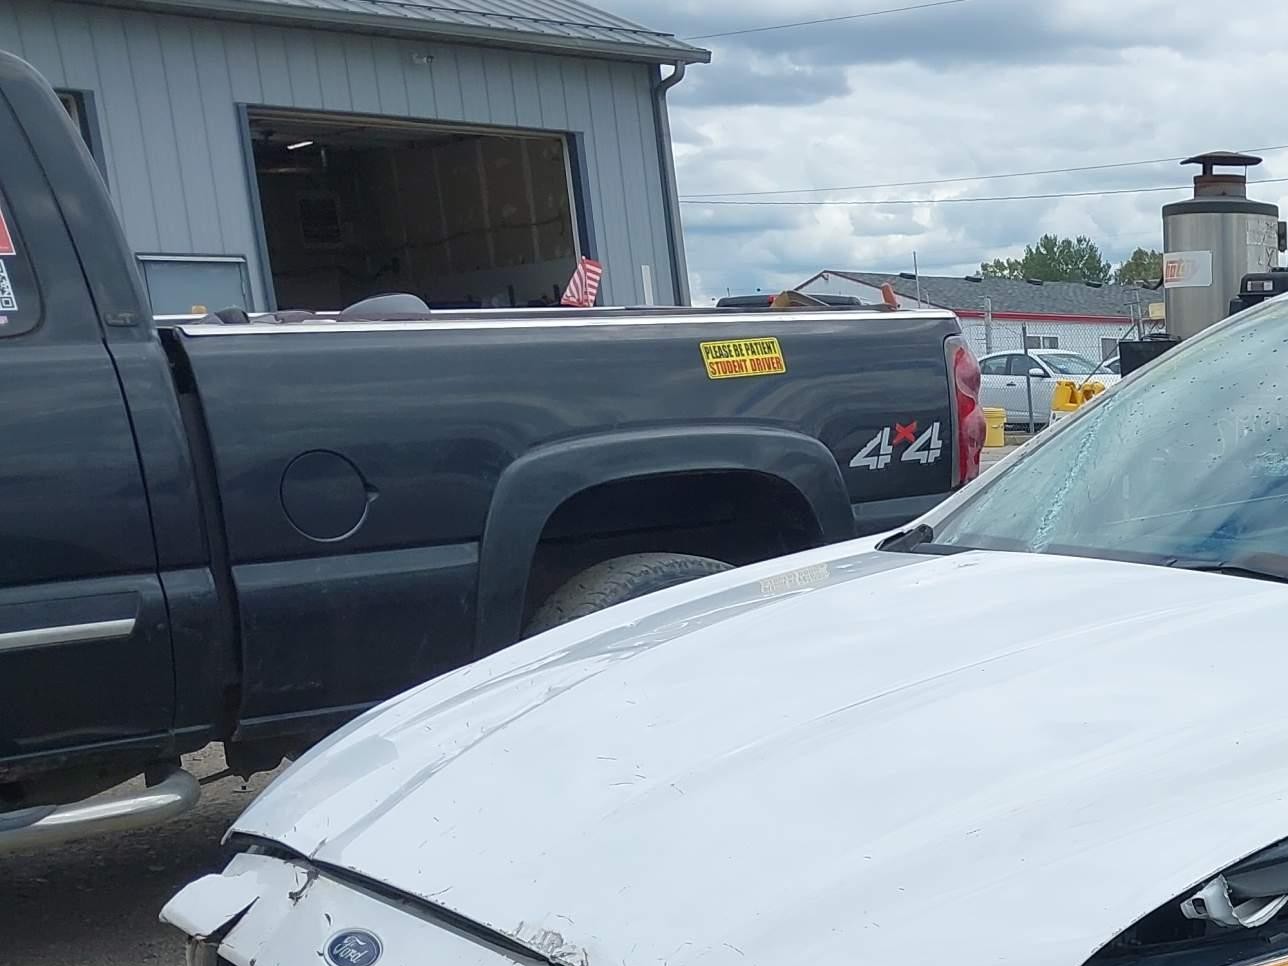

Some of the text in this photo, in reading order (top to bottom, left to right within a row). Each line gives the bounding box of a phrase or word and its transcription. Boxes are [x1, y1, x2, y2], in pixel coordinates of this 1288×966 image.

[704, 341, 777, 360] PLEASE BE PATIENT
[709, 356, 782, 375] STUDENT DRIVER
[333, 936, 368, 963] Ford
